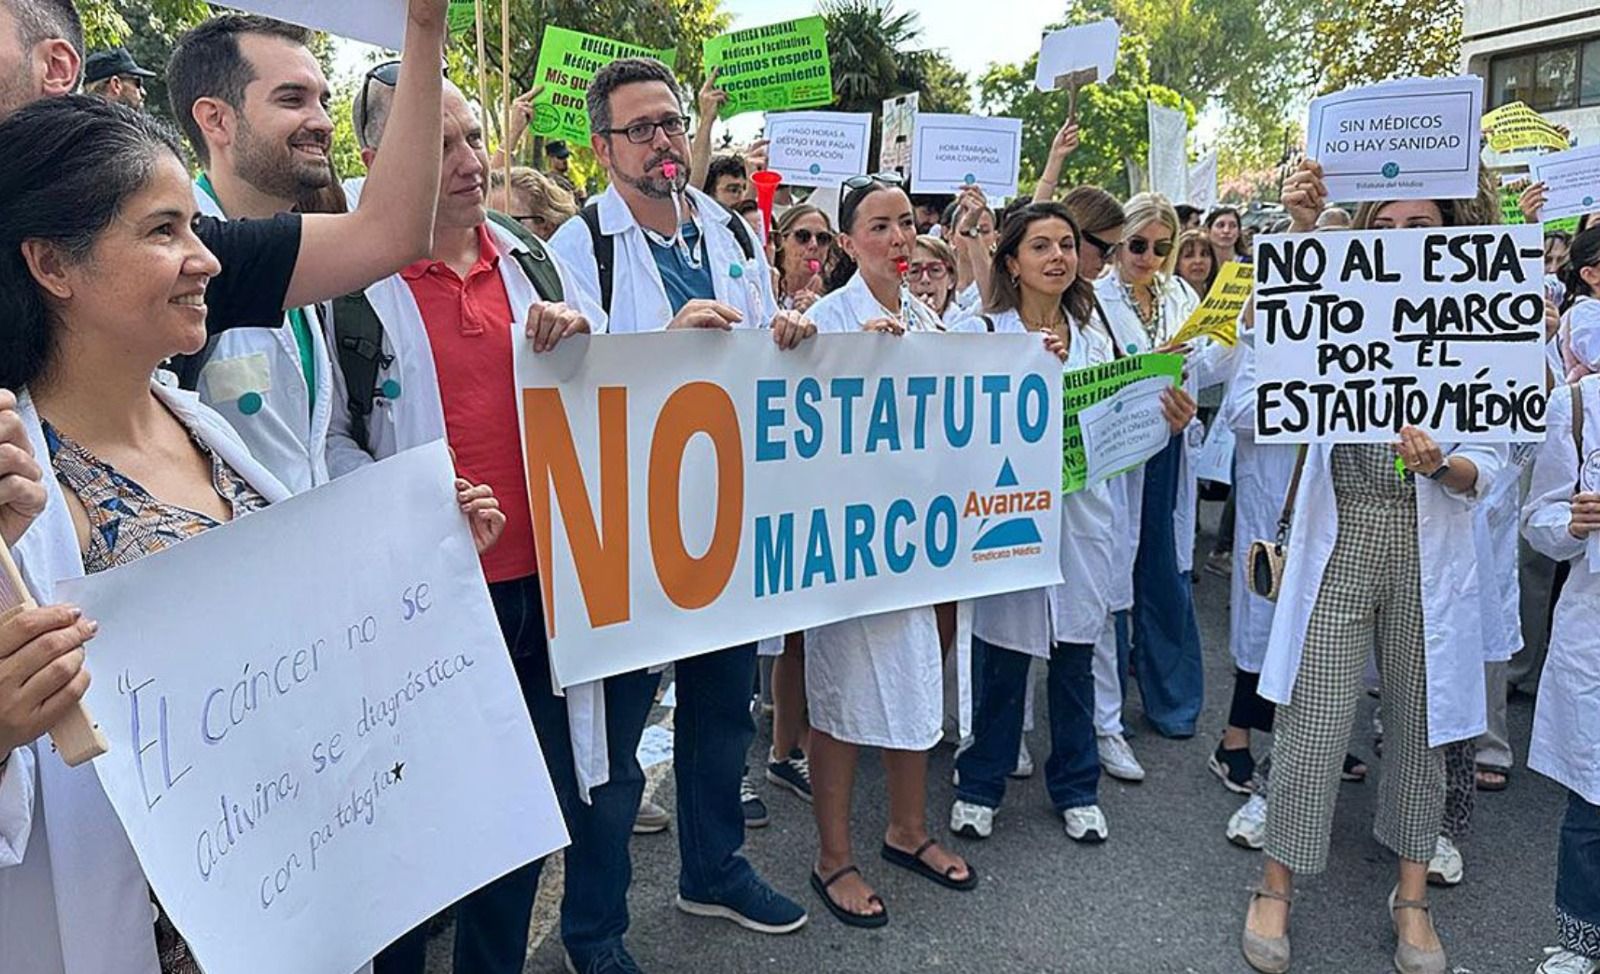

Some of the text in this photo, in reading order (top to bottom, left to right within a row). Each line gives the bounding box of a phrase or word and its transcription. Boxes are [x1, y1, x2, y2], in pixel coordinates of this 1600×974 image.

[731, 21, 797, 43] HUELGA NACIONAL
[580, 37, 615, 57] HUELGA
[772, 48, 823, 67] respeto
[545, 66, 588, 91] Mis gu
[722, 65, 826, 92] reconocimiento
[552, 92, 584, 110] pero
[788, 127, 846, 138] HAGO HORAS A
[1340, 114, 1442, 133] SIN MÉDICOS
[776, 136, 808, 147] DESTAJO
[829, 140, 856, 150] PAGAN
[785, 147, 803, 157] CON
[1325, 135, 1461, 153] NO HAY SANIDAD
[936, 153, 956, 162] HORA
[1257, 234, 1543, 284] NO AL ESTA-
[1257, 292, 1543, 344] TUTO MARCO
[1098, 357, 1143, 381] NACIONAL
[1317, 340, 1461, 375] POR EL
[755, 372, 1050, 462] ESTATUTO
[1257, 377, 1428, 436] ESTATUTO
[522, 381, 744, 639] NO
[963, 490, 1051, 518] Avanza
[754, 495, 957, 599] MARCO
[972, 550, 1010, 562] Sindicato
[202, 638, 325, 745] cáncer
[347, 615, 377, 650] no
[401, 583, 432, 621] se
[313, 733, 345, 774] se
[356, 653, 474, 738] diagnóstica
[261, 854, 301, 909] con
